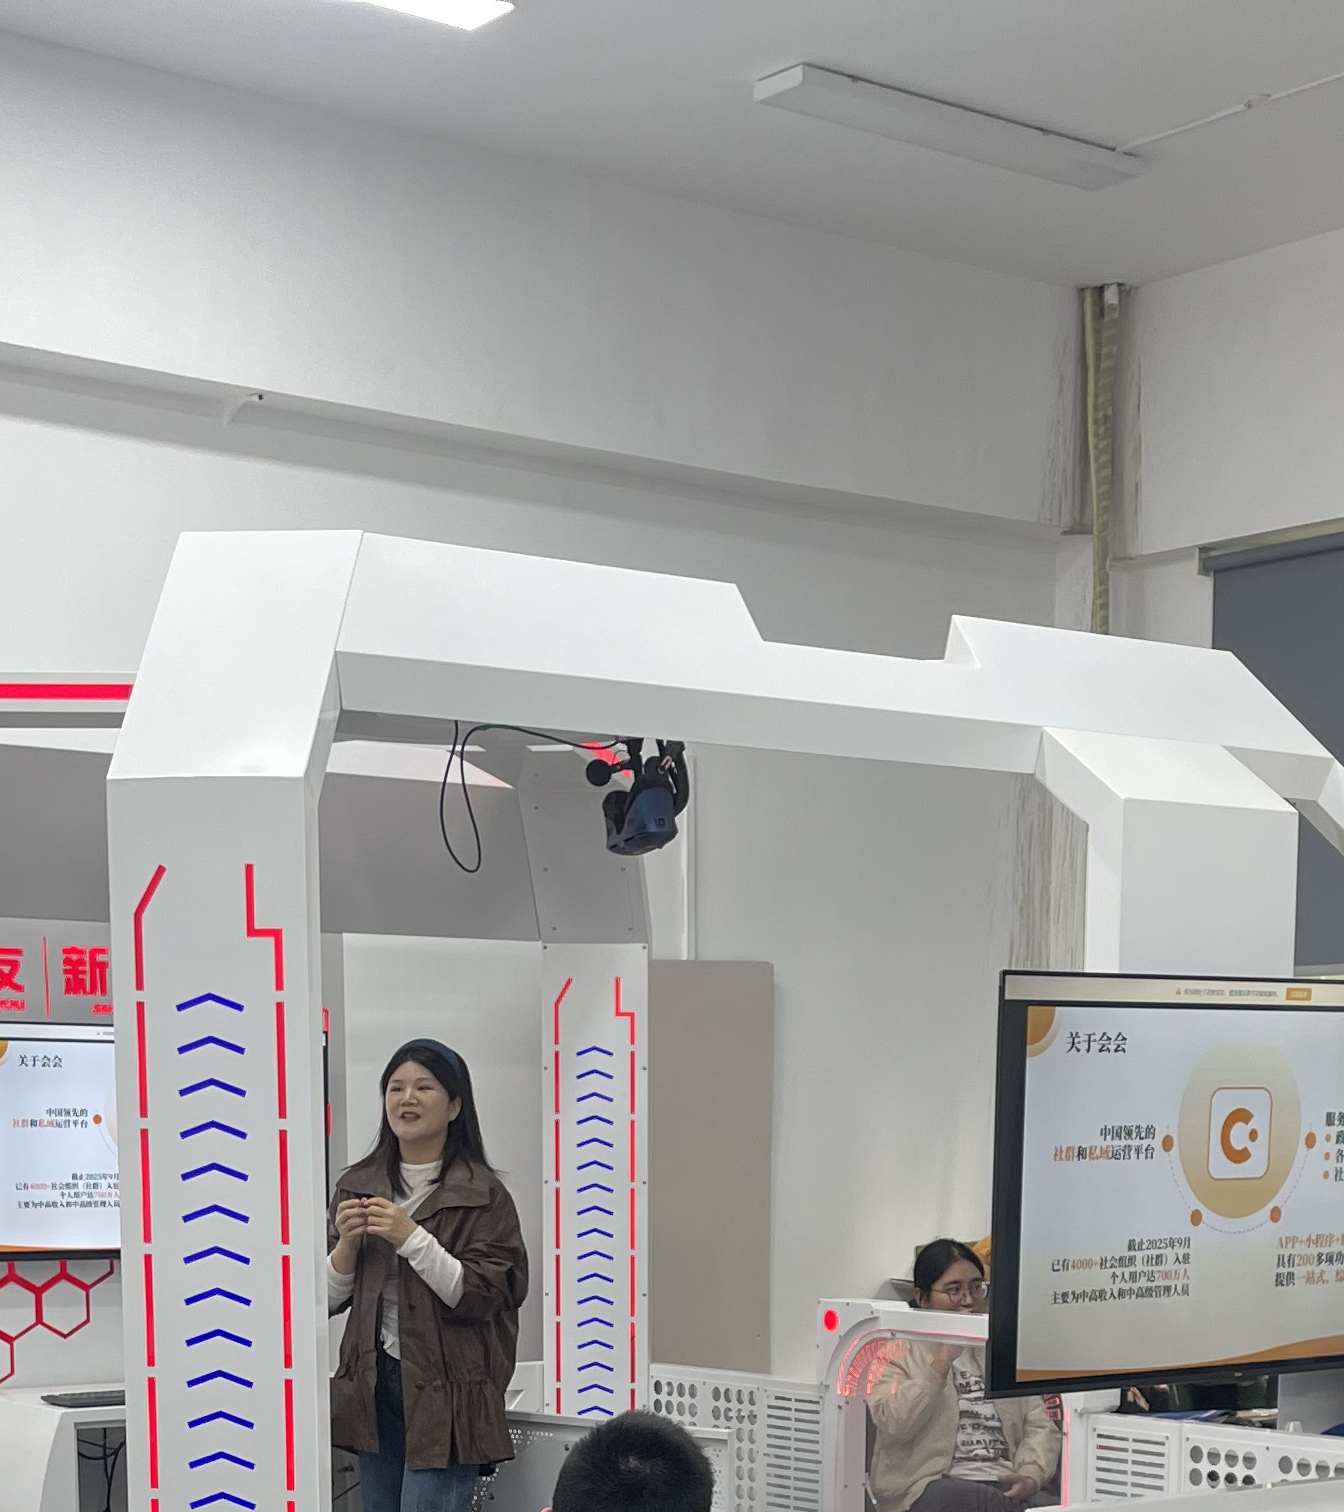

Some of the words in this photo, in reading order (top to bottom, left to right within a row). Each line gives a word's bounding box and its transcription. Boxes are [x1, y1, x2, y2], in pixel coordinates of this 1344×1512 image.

[61, 944, 110, 997] 新
[1066, 1031, 1128, 1054] 关于会会
[17, 1054, 63, 1068] 关于会会
[1099, 1124, 1157, 1141] 中国领先的
[1053, 1143, 1156, 1162] 社群和私域运营平台
[1126, 1236, 1192, 1253] 截止2025年9月
[1110, 1268, 1191, 1285] 个人用户达700万人
[1050, 1284, 1190, 1305] 主要为中高收入和中高级管理人员
